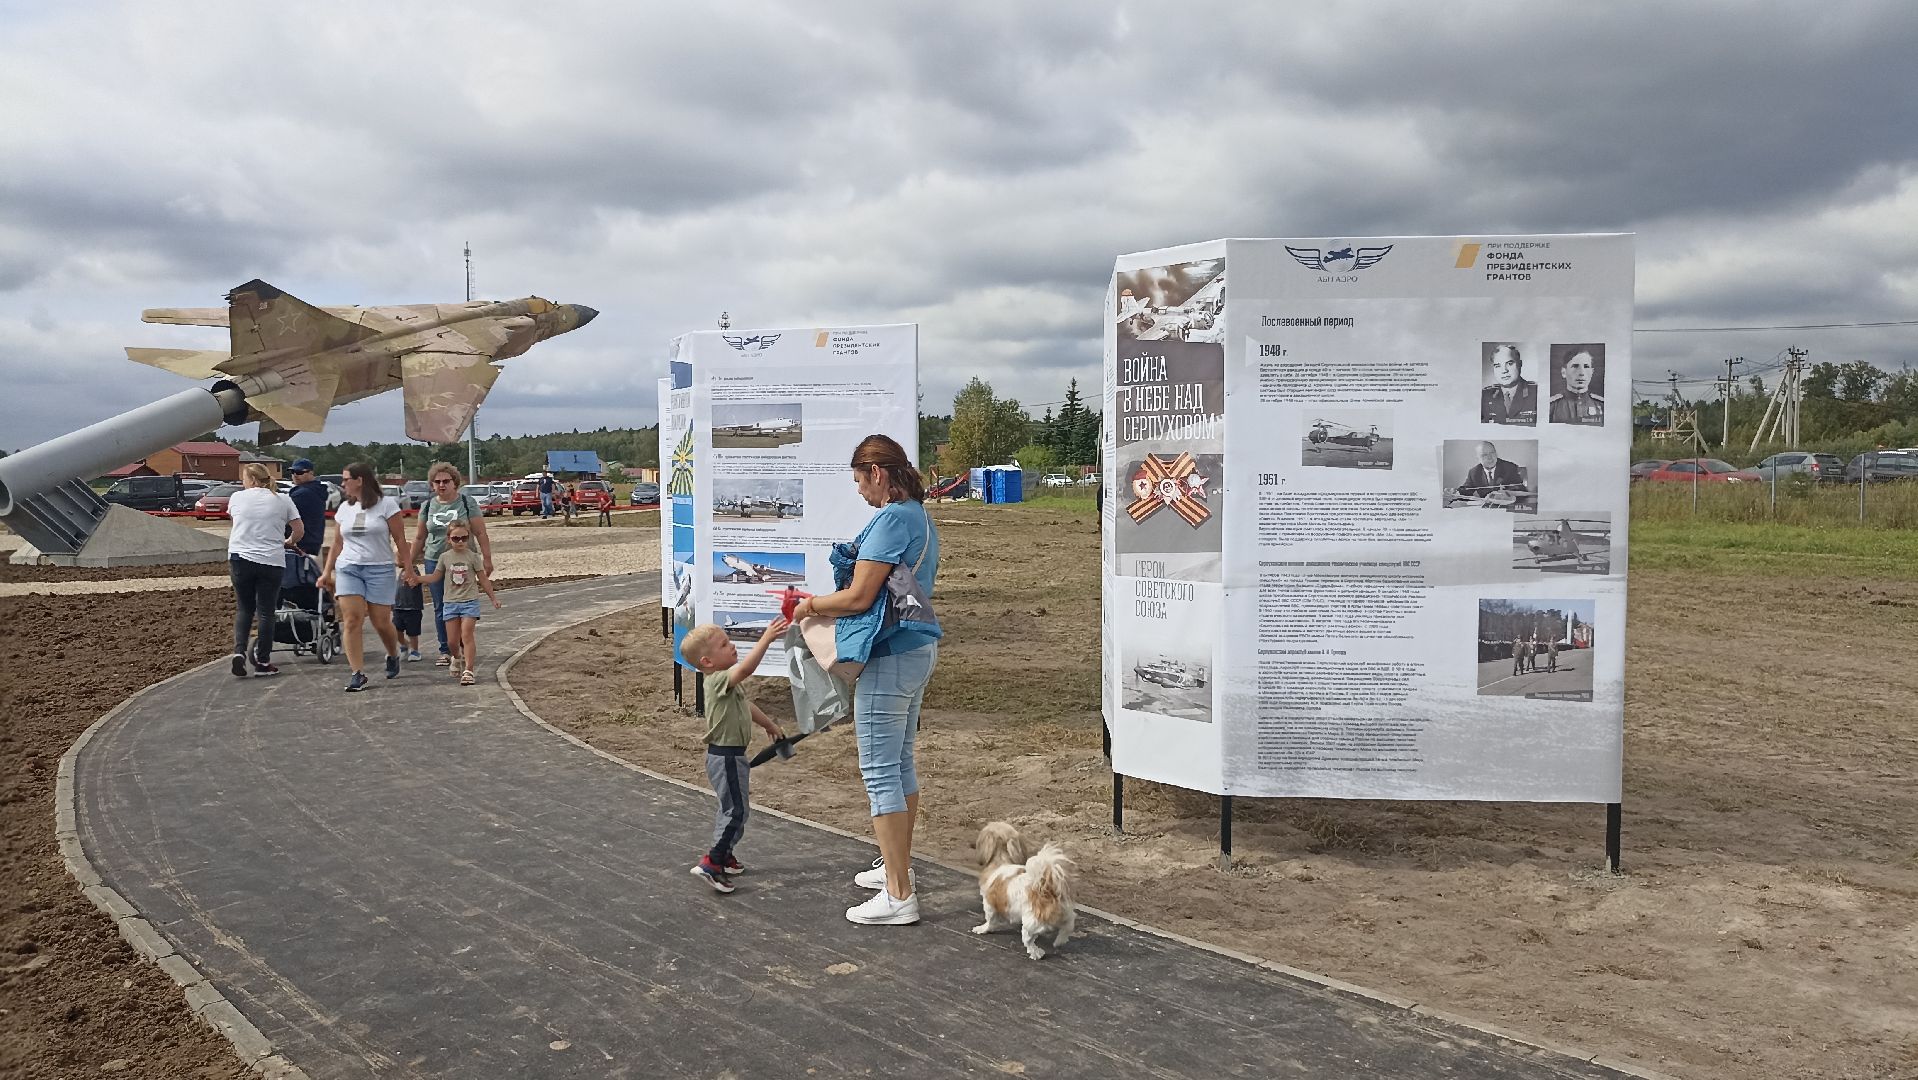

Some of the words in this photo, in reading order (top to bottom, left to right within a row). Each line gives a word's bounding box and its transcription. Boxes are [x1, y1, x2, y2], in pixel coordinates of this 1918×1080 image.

[1486, 252, 1524, 261] ФОНДА
[1486, 262, 1572, 271] ПРЕЗИДЕНТСКИХ
[1486, 273, 1532, 281] ГРАНТОВ
[1261, 315, 1322, 327] Послевоенный
[1323, 317, 1354, 329] период
[1259, 344, 1281, 357] 1948
[1123, 351, 1168, 384] ВОЙНА
[1123, 388, 1132, 413] В
[1135, 385, 1170, 412] НЕБЕ
[1174, 383, 1204, 414] НАД
[1123, 413, 1215, 442] СЕРПУХОВОМ
[1258, 473, 1278, 486] 1951
[1135, 559, 1165, 578] ГЕРОИ
[1135, 580, 1194, 602] СОВЕТСКОГО
[1135, 600, 1168, 620] СОЮЗА
